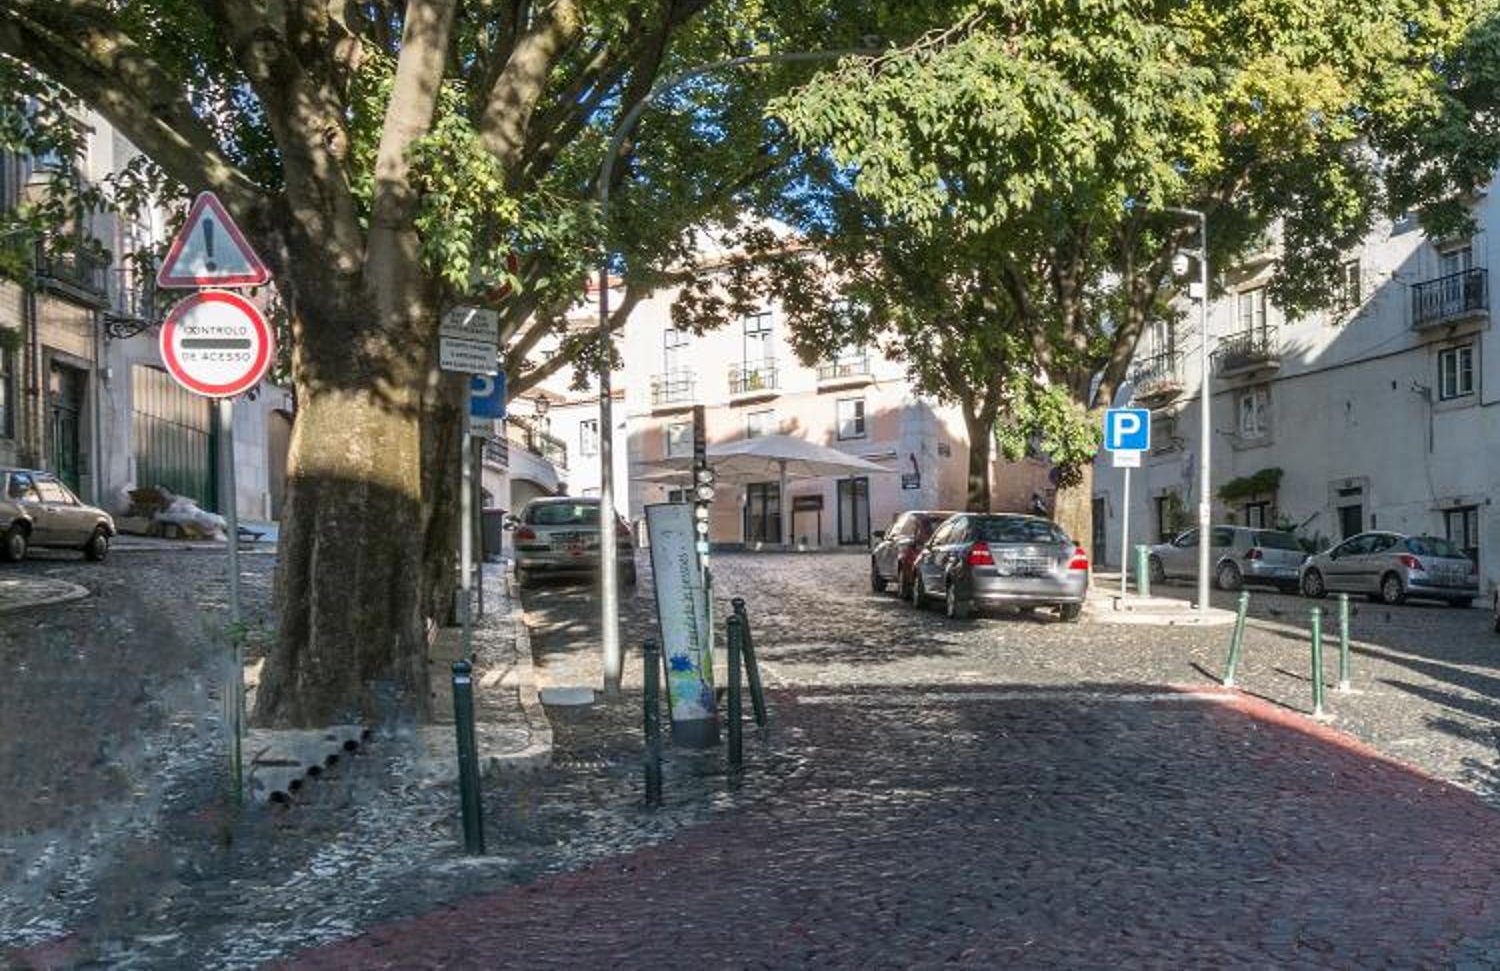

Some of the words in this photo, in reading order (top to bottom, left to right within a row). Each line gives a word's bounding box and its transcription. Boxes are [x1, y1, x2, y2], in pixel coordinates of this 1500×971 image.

[184, 327, 247, 335] CONTROLO
[181, 352, 197, 362] DE
[201, 352, 251, 362] ACESSO
[1114, 413, 1141, 447] P
